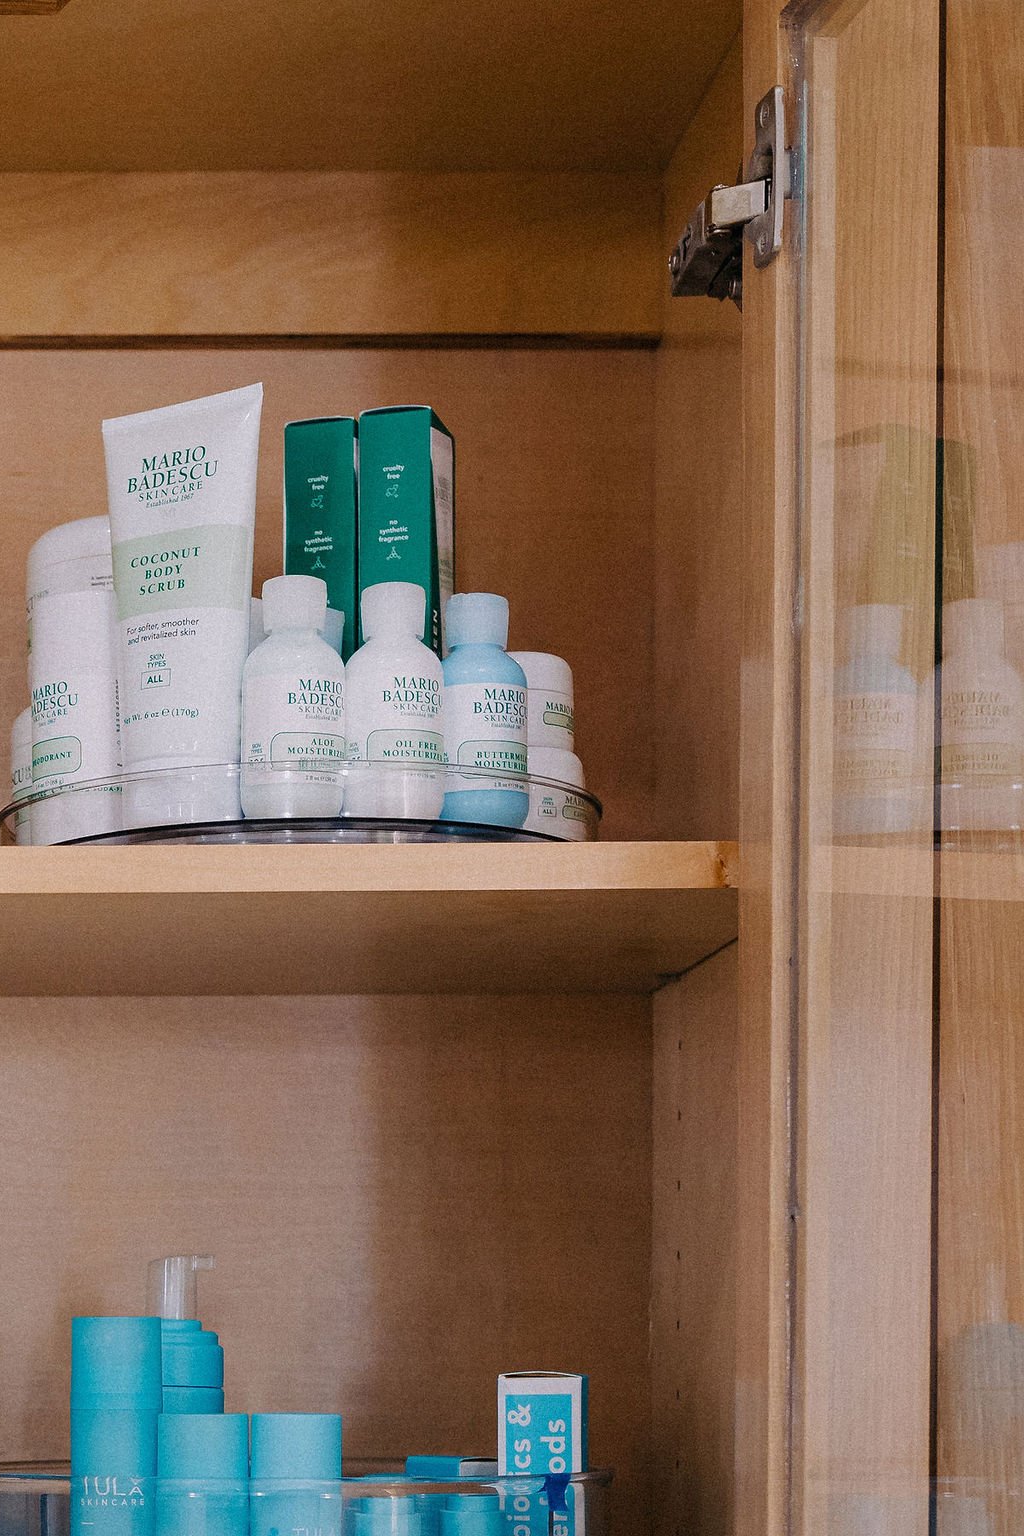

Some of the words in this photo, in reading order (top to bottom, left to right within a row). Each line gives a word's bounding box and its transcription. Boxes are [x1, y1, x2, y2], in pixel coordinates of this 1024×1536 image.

[141, 445, 207, 473] MARIO
[383, 464, 405, 473] cruelty
[127, 460, 218, 493] BADESCU
[307, 474, 329, 484] cruelty
[138, 488, 169, 503] SKIN
[171, 481, 204, 496] CARE
[379, 526, 408, 535] synthetic
[305, 536, 333, 545] synthetic
[378, 534, 409, 543] fragrance
[304, 544, 333, 554] fragrance
[130, 546, 201, 568] COCONUT
[145, 564, 183, 580] BODY
[139, 579, 185, 596] SCRUB
[161, 618, 200, 629] smoother
[140, 630, 178, 643] revitalized
[180, 628, 196, 637] skin
[147, 660, 166, 668] TYPES
[147, 675, 164, 684] ALL
[394, 677, 439, 692] MARIO
[299, 679, 342, 695] MARIO
[484, 688, 525, 704] MARIO
[46, 708, 68, 718] CARE
[172, 708, 200, 719] (170g)
[325, 707, 342, 717] CARE
[393, 703, 417, 711] SKIN
[420, 704, 439, 714] CARE
[311, 738, 335, 748] ALOE
[395, 740, 413, 748] OIL
[419, 741, 438, 751] FREE
[288, 747, 345, 760] MOISTURIZE
[477, 751, 527, 762] BUTTERMIL
[507, 1404, 531, 1427] &
